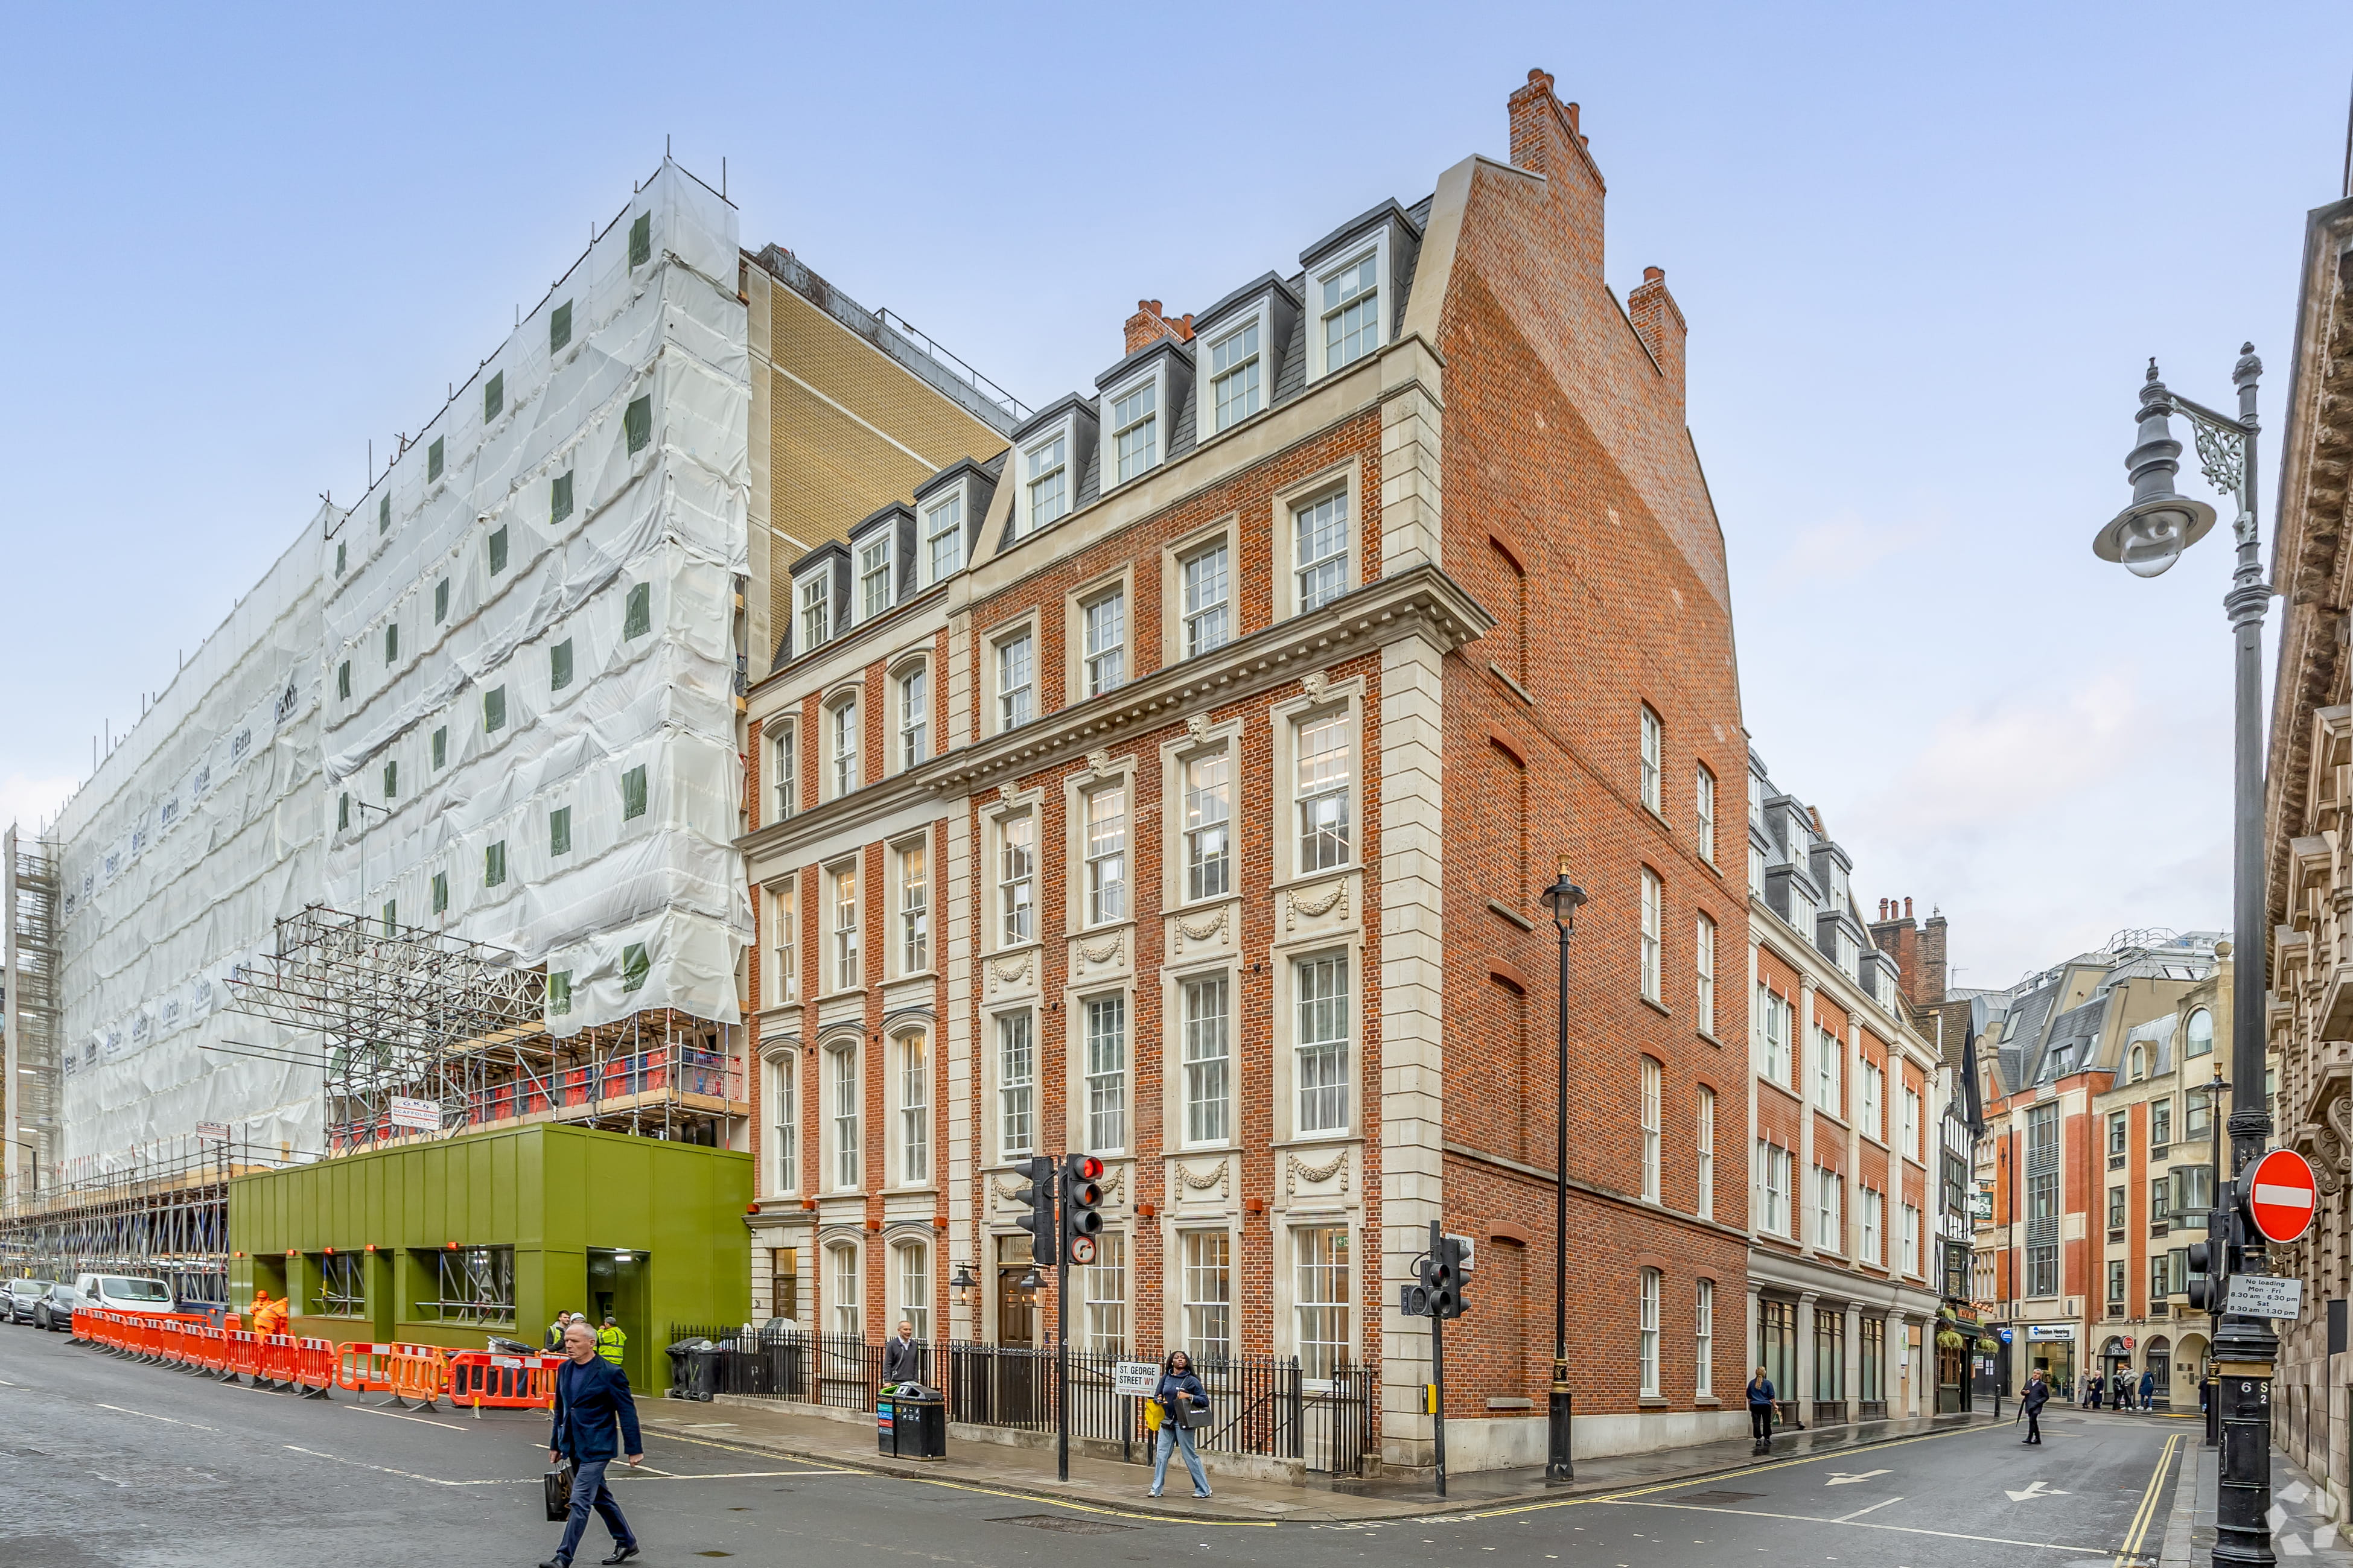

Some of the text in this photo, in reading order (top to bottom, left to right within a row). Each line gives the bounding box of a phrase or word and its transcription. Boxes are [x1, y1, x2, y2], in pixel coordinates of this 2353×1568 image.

[403, 1101, 429, 1109] GKR
[393, 1108, 439, 1119] SCAFFOLDING
[1119, 1365, 1155, 1376] ST. GEORGE
[1119, 1376, 1153, 1386] STREET W1
[2241, 1382, 2268, 1392] 6 S
[2261, 1394, 2267, 1404] 2
